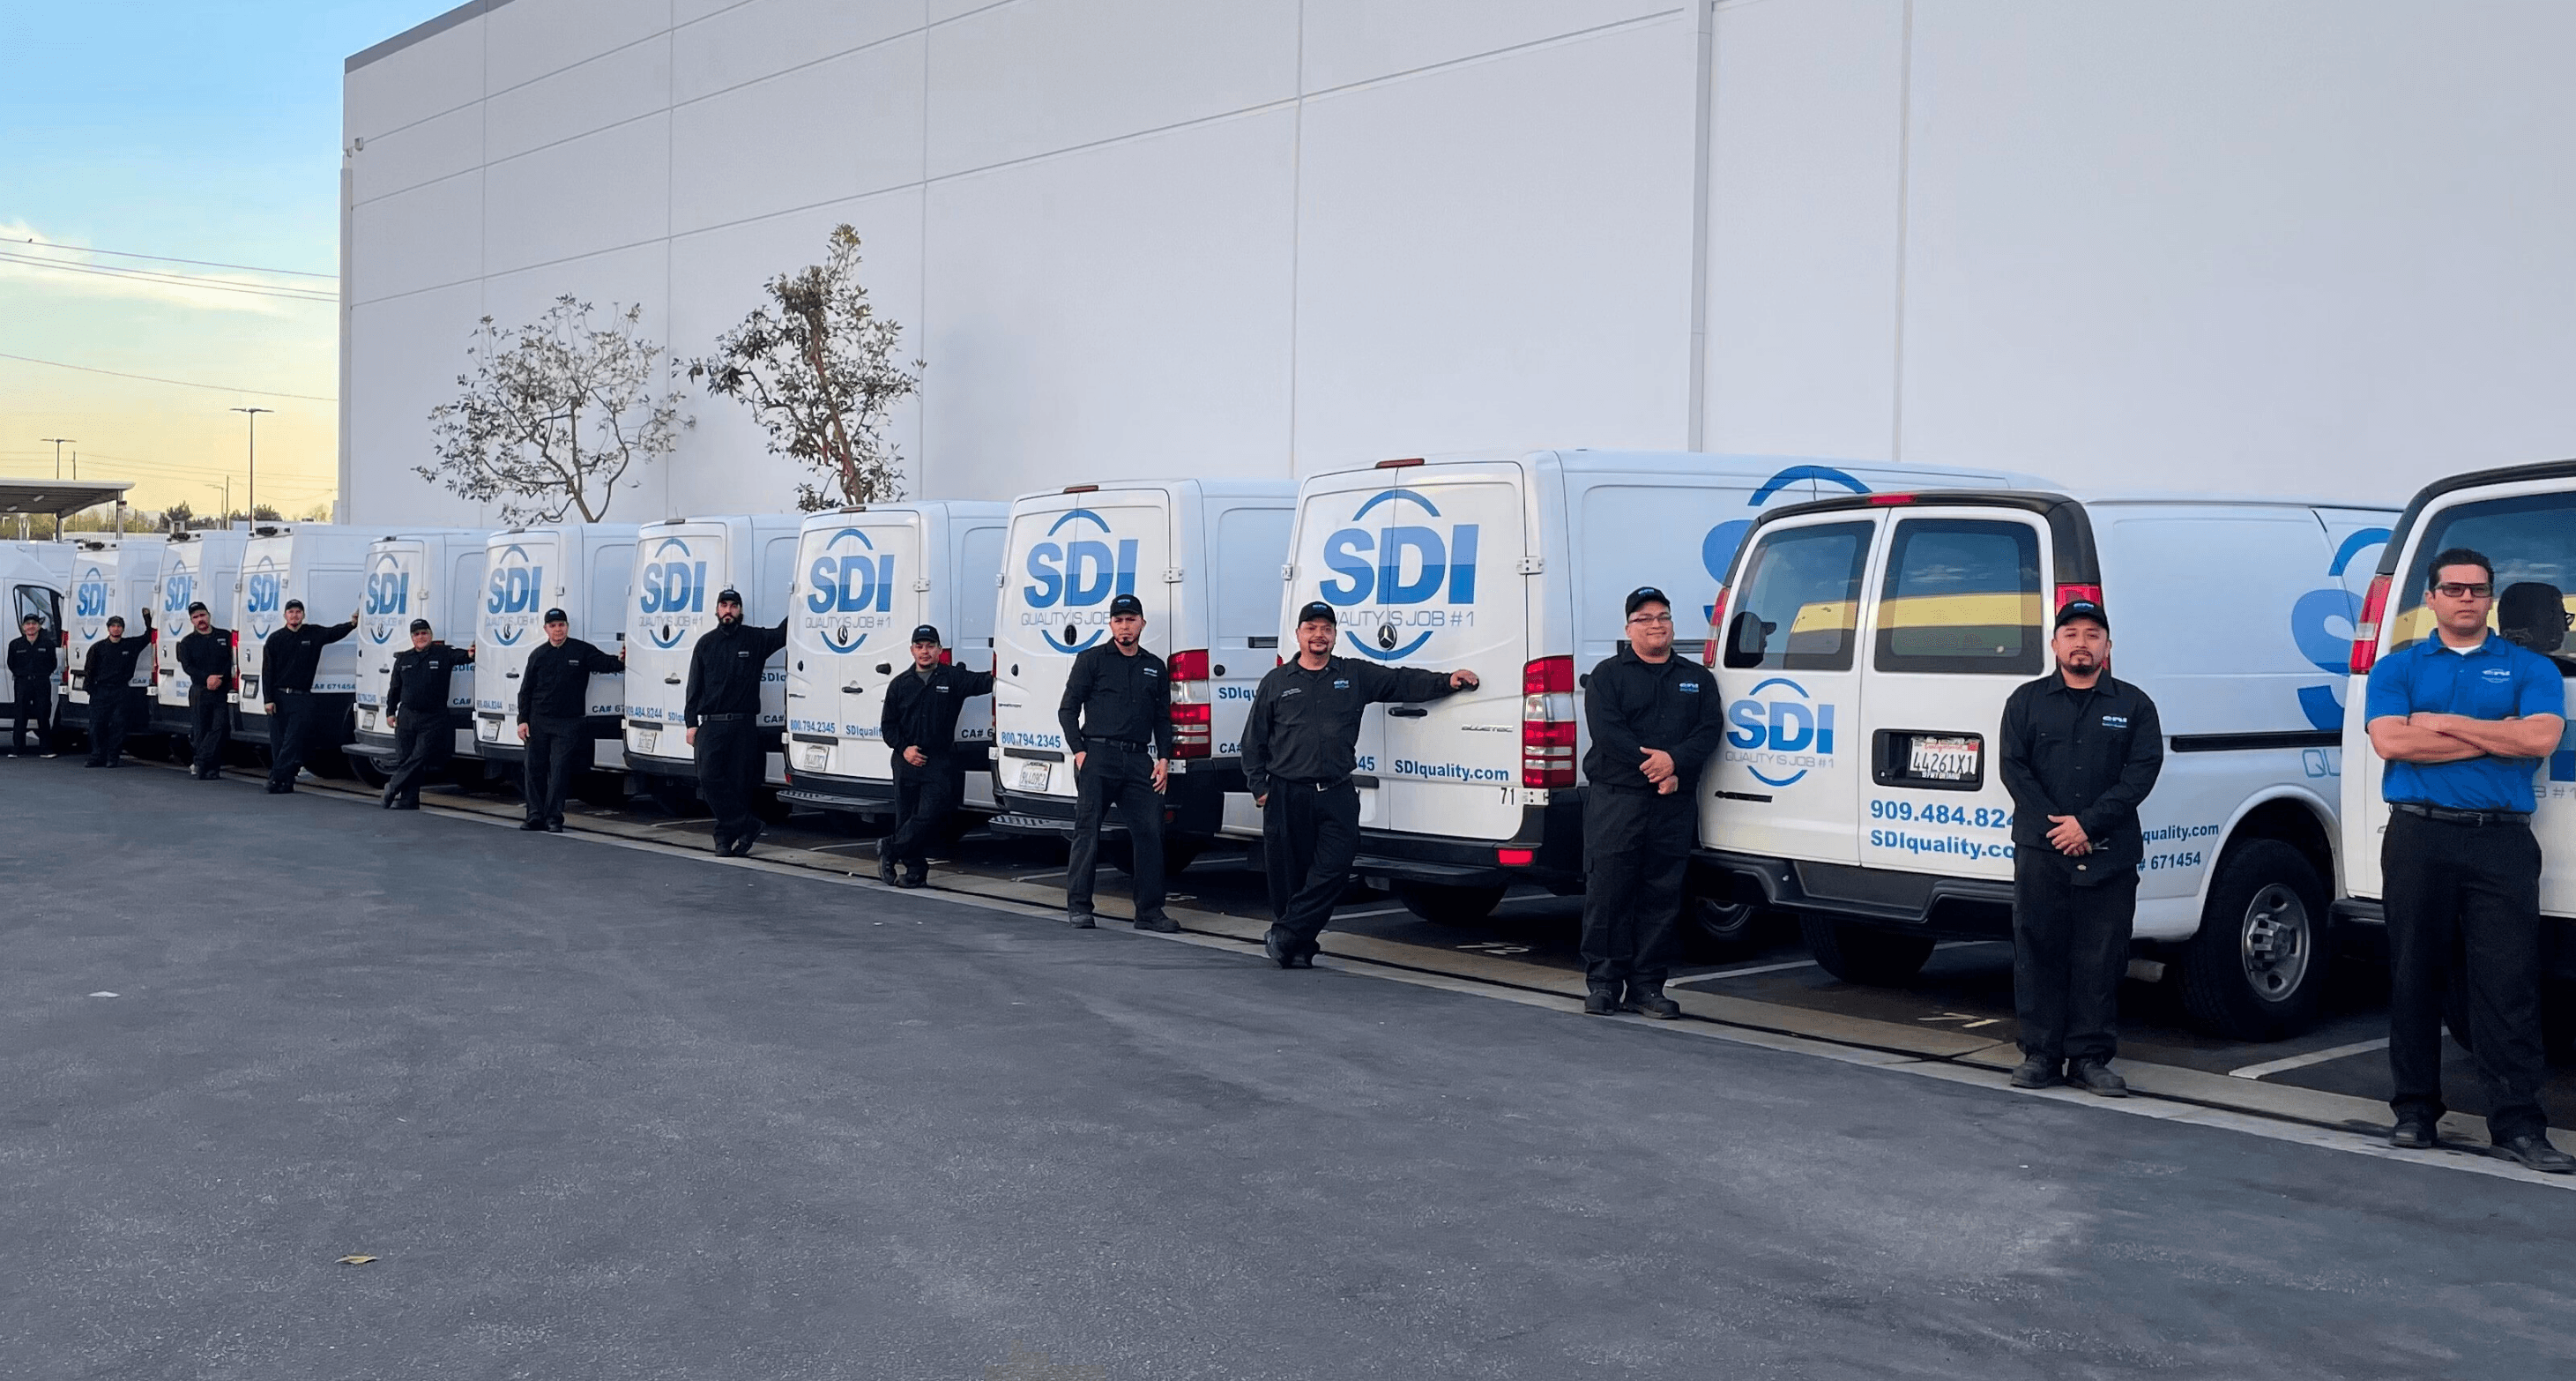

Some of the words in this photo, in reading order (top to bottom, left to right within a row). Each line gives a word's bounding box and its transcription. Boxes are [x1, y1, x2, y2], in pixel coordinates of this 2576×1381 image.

[1024, 539, 1139, 608] SDI
[1320, 524, 1479, 607] SDI
[165, 576, 192, 611] SDI
[248, 573, 281, 612] SDI
[366, 572, 409, 615] SDI
[488, 566, 542, 614] SDI
[640, 561, 707, 613] SDI
[808, 555, 895, 613] SDI
[77, 583, 108, 616] SDI
[805, 616, 842, 629] QUALITY
[852, 616, 875, 629] JOB
[1021, 611, 1070, 626] QUALITY
[1336, 610, 1385, 626] ALITY
[1389, 610, 1403, 626] IS
[1406, 610, 1445, 626] JOB
[1450, 610, 1474, 627] #1
[790, 719, 836, 734] 800.794.2345
[961, 729, 983, 739] CA#
[1001, 731, 1061, 749] 800.794.2345
[1726, 699, 1835, 755] SDI
[1395, 758, 1509, 782] SDIquality.com
[1725, 750, 1775, 765] QUALITY
[1789, 756, 1816, 767] JOB
[1913, 751, 1972, 775] 44261X1
[1500, 787, 1515, 805] 71
[1870, 799, 2014, 829] 909.484.82
[1870, 829, 2015, 860] SDIquality.co
[2142, 825, 2219, 845] quality.com
[2151, 851, 2201, 870] 671454
